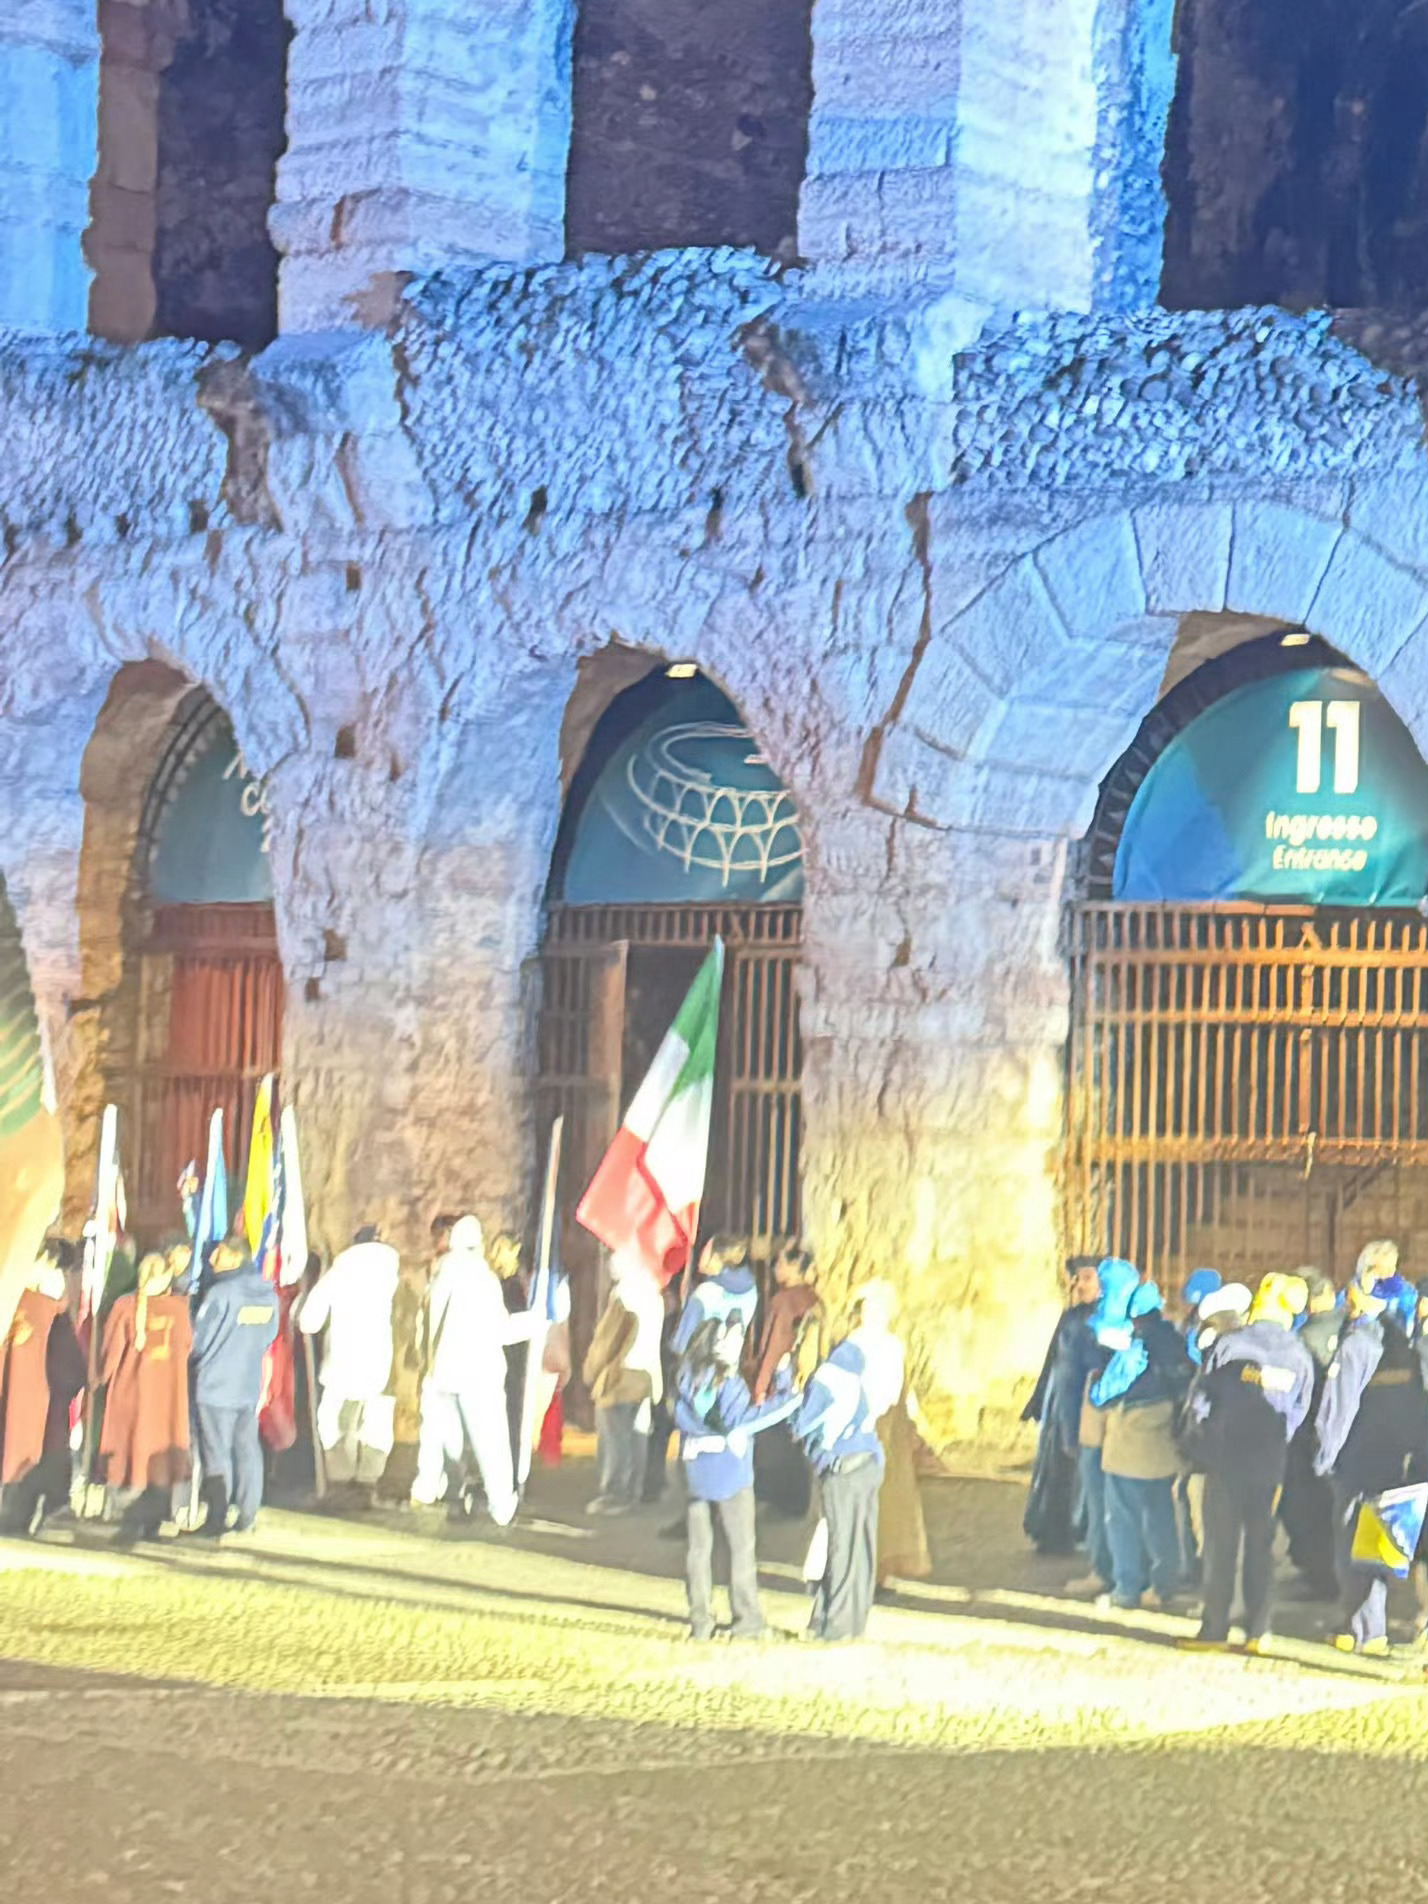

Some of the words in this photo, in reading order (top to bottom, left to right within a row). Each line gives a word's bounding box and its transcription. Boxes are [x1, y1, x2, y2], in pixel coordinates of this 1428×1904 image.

[1288, 700, 1361, 794] 11
[1265, 810, 1378, 847] Ingresso
[1272, 844, 1369, 872] Entrance
